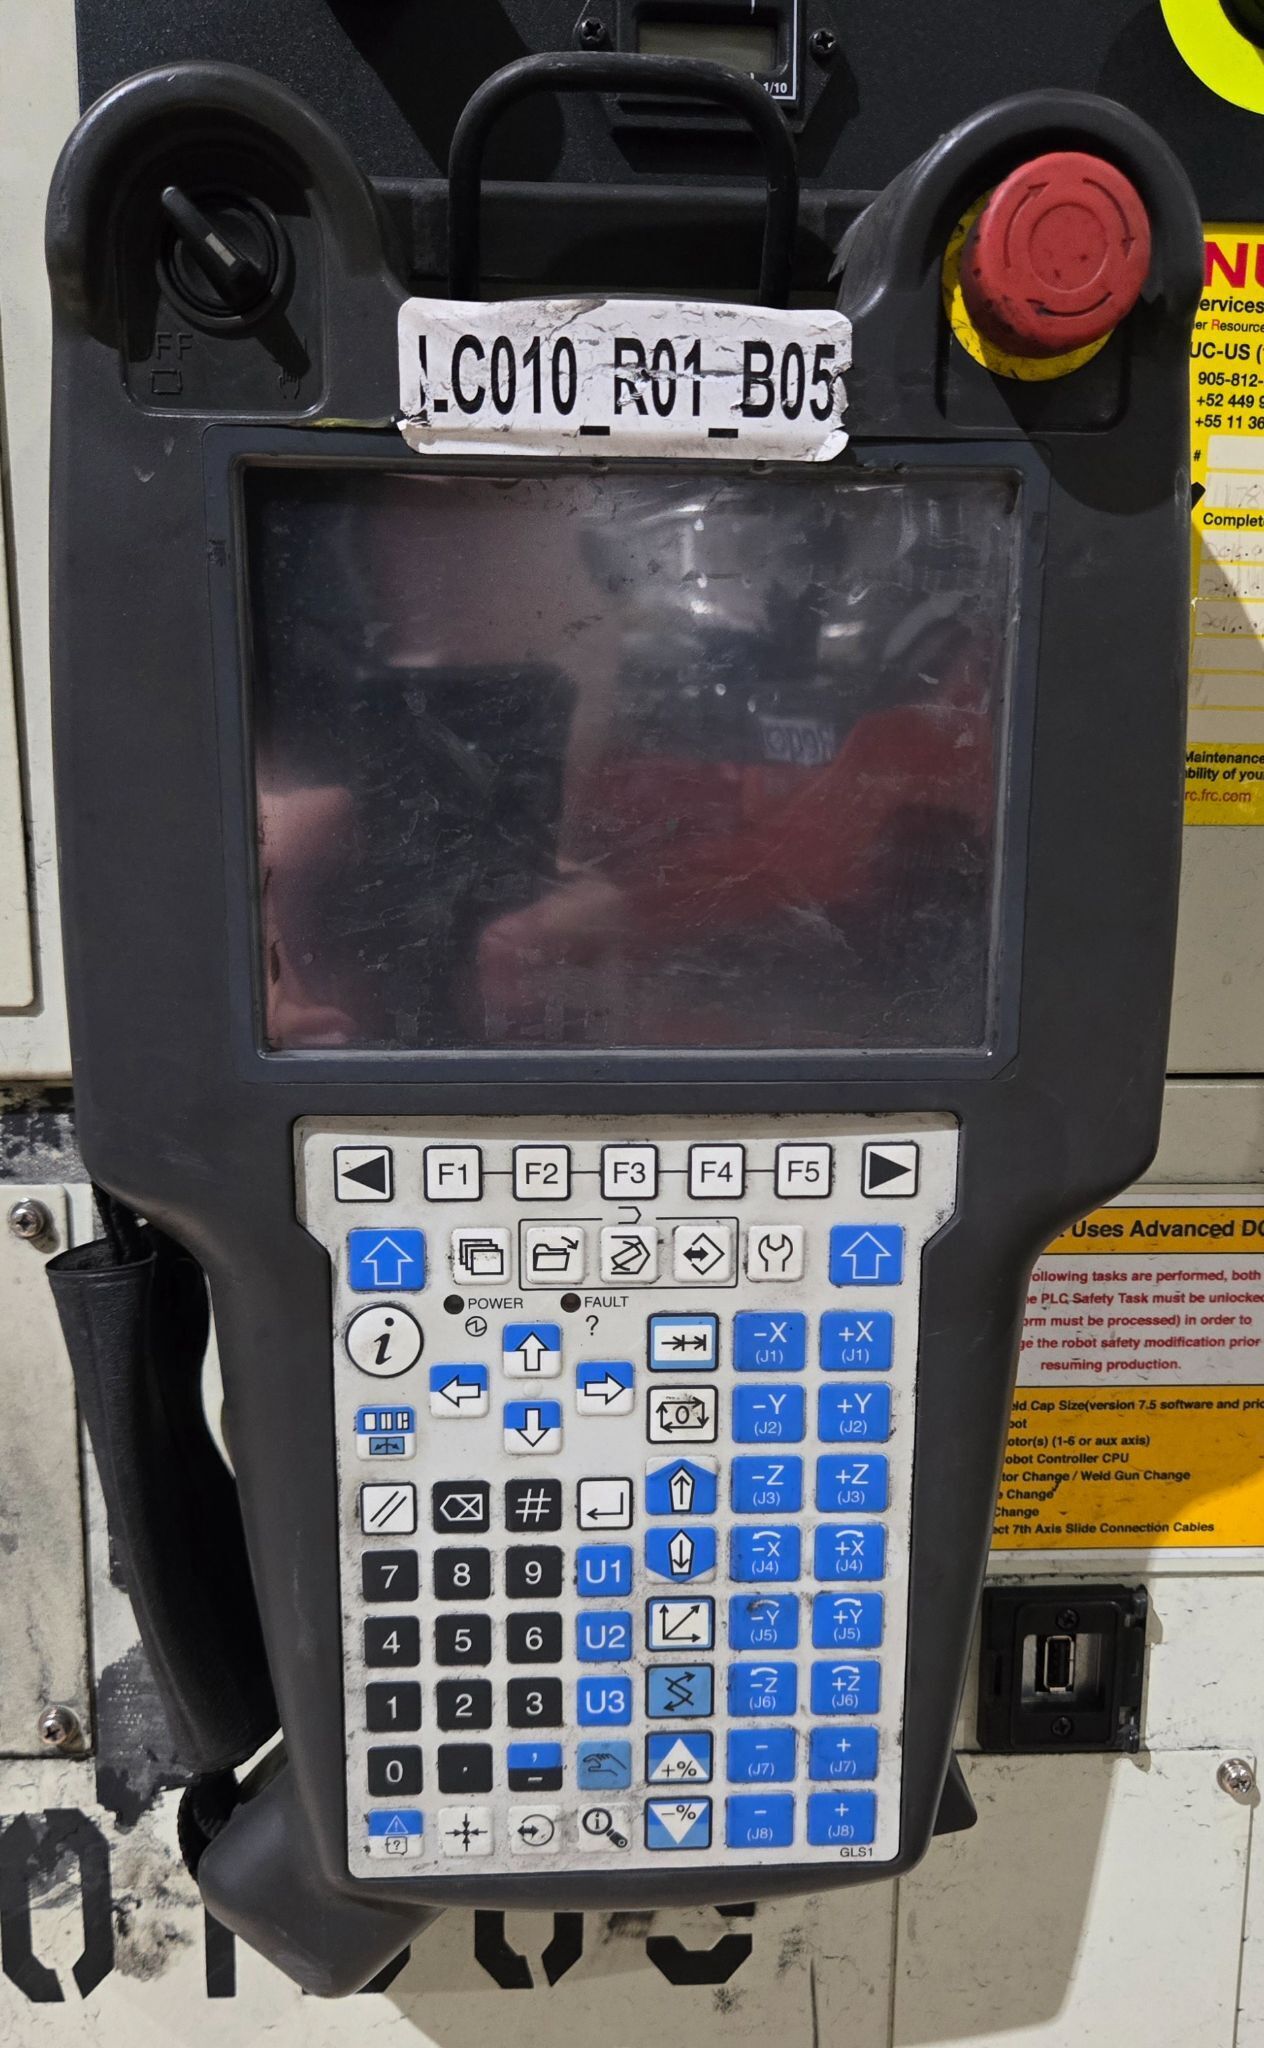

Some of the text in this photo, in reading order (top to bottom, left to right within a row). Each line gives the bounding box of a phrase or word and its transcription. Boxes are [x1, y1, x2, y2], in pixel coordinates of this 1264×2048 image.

[1200, 296, 1264, 313] ervices
[1190, 341, 1251, 360] UC-US
[1198, 371, 1264, 387] 905-812-
[1196, 393, 1223, 407] +52
[1228, 394, 1254, 408] 449
[1195, 414, 1221, 428] +55
[1228, 415, 1242, 429] 11
[1203, 512, 1264, 529] Complet
[1223, 768, 1236, 780] of
[1239, 770, 1264, 782] you
[439, 1160, 819, 1185] F1 F2 F3 F4 F5
[1072, 1220, 1124, 1237] Uses
[1129, 1219, 1235, 1237] Advanced
[1032, 1270, 1262, 1284] ollowing tasks are performed, both
[468, 1298, 523, 1310] POWER
[584, 1296, 629, 1308] FAULT
[1041, 1293, 1068, 1304] PLC
[1073, 1292, 1114, 1306] Safety
[1118, 1292, 1149, 1303] Task
[1152, 1293, 1185, 1303] must
[1189, 1292, 1205, 1303] be
[1023, 1314, 1252, 1328] orm must be processed) in order to
[838, 1320, 874, 1342] +X
[1020, 1338, 1034, 1351] ge
[1037, 1338, 1058, 1348] the
[1061, 1337, 1097, 1348] robot
[1101, 1337, 1140, 1350] safety
[1144, 1335, 1225, 1348] modification
[755, 1349, 784, 1365] (J1)
[841, 1348, 870, 1364] (J1)
[1040, 1358, 1181, 1373] resuming production.
[837, 1393, 872, 1414] +Y
[1031, 1400, 1055, 1413] Cap
[1160, 1399, 1213, 1409] software
[1217, 1398, 1240, 1409] and
[754, 1421, 782, 1437] (J2)
[839, 1420, 867, 1435] (J2)
[1007, 1436, 1048, 1448] otor(s)
[1079, 1438, 1092, 1446] or
[1095, 1437, 1117, 1446] aux
[1121, 1435, 1151, 1447] axis)
[1005, 1453, 1129, 1464] obot Controller CPU
[835, 1463, 870, 1485] +Z
[1022, 1471, 1070, 1484] Change
[1081, 1471, 1111, 1481] Weld
[1115, 1470, 1140, 1481] Gun
[1143, 1470, 1191, 1482] Change
[752, 1491, 781, 1506] (J3)
[837, 1490, 865, 1505] (J3)
[1007, 1489, 1054, 1502] Change
[1013, 1523, 1032, 1534] 7th
[1035, 1523, 1062, 1534] Axis
[1066, 1523, 1097, 1534] Slide
[1100, 1522, 1169, 1534] Connection
[1173, 1521, 1215, 1532] Cables
[835, 1540, 864, 1556] +X
[453, 1562, 471, 1587] 8
[524, 1561, 542, 1585] 9
[585, 1560, 621, 1584] U1
[751, 1560, 779, 1575] (J4)
[835, 1559, 863, 1574] (J4)
[380, 1565, 399, 1589] 7
[833, 1608, 863, 1625] +Y
[382, 1630, 400, 1654] 4
[455, 1629, 472, 1652] 5
[525, 1627, 543, 1650] 6
[585, 1625, 625, 1649] U2
[750, 1629, 778, 1644] (J5)
[833, 1627, 861, 1642] (J5)
[832, 1676, 860, 1692] +Z
[386, 1696, 398, 1719] 1
[455, 1694, 473, 1718] 2
[526, 1692, 543, 1716] 3
[585, 1690, 625, 1714] U3
[749, 1695, 776, 1711] (J6)
[831, 1694, 859, 1709] (J6)
[386, 1760, 403, 1783] 0
[748, 1762, 775, 1777] (J7)
[830, 1760, 857, 1775] (J7)
[746, 1826, 773, 1841] (J8)
[827, 1824, 855, 1839] (J8)
[840, 1847, 873, 1858] GLS1
